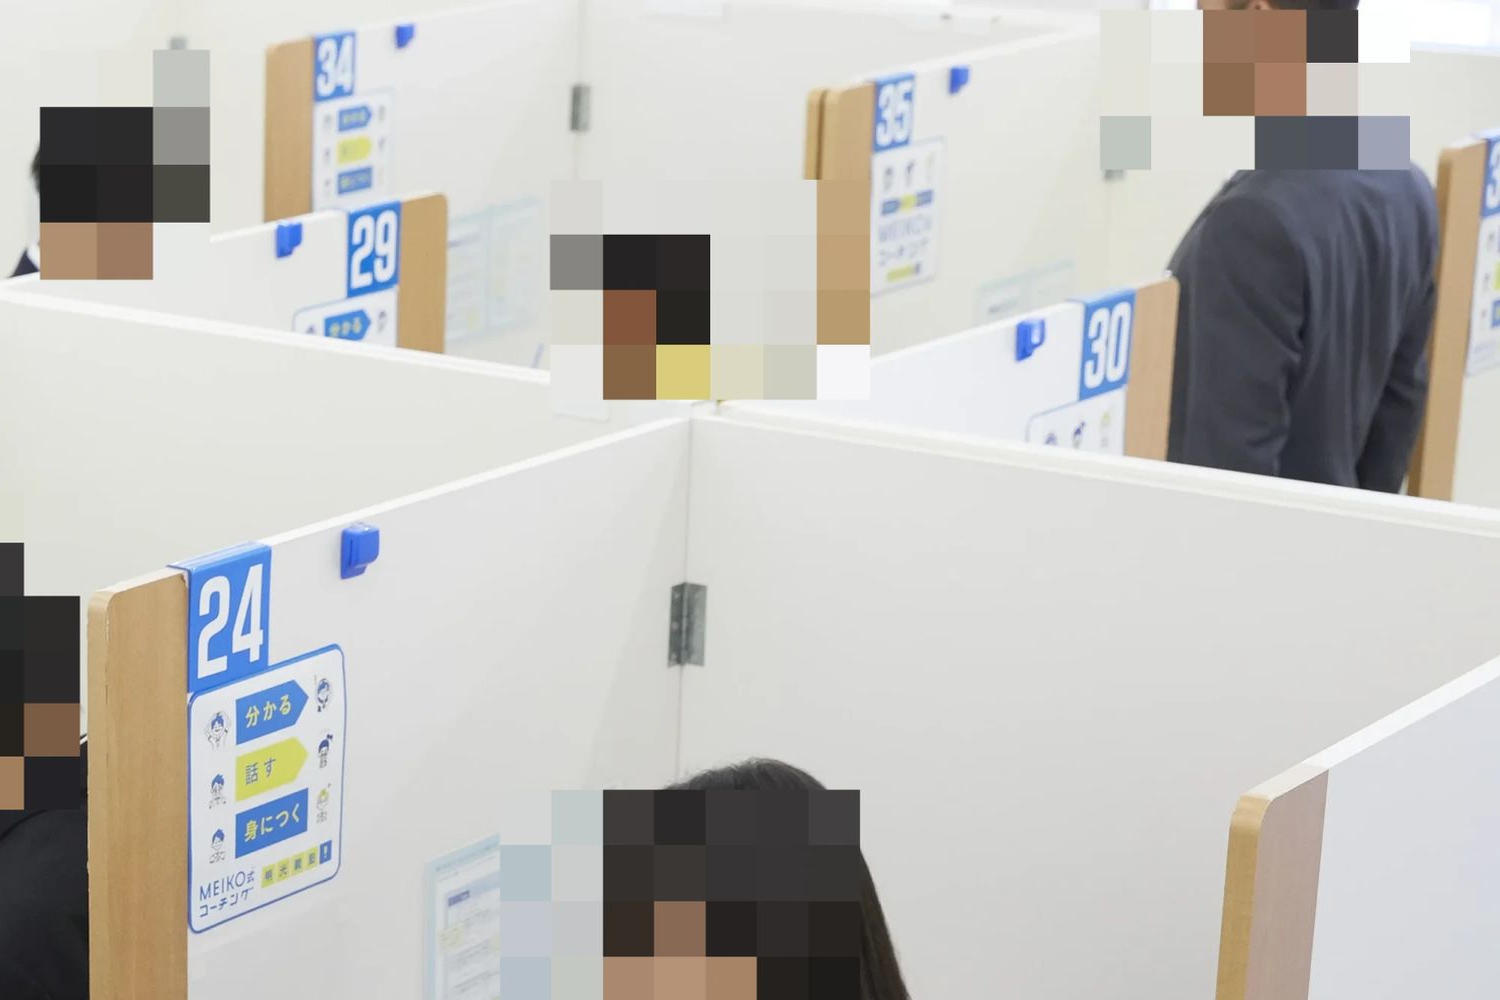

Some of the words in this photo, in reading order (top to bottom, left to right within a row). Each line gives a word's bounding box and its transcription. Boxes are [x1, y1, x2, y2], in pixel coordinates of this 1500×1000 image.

[316, 35, 354, 97] 34
[876, 80, 913, 147] 35
[350, 210, 398, 290] 29
[1084, 302, 1131, 389] 30
[197, 564, 263, 679] 24
[245, 695, 292, 729] 分かる
[245, 757, 277, 786] 話す
[244, 811, 301, 842] 身につく
[200, 869, 255, 901] MEIKO式
[200, 886, 255, 917] コーチング
